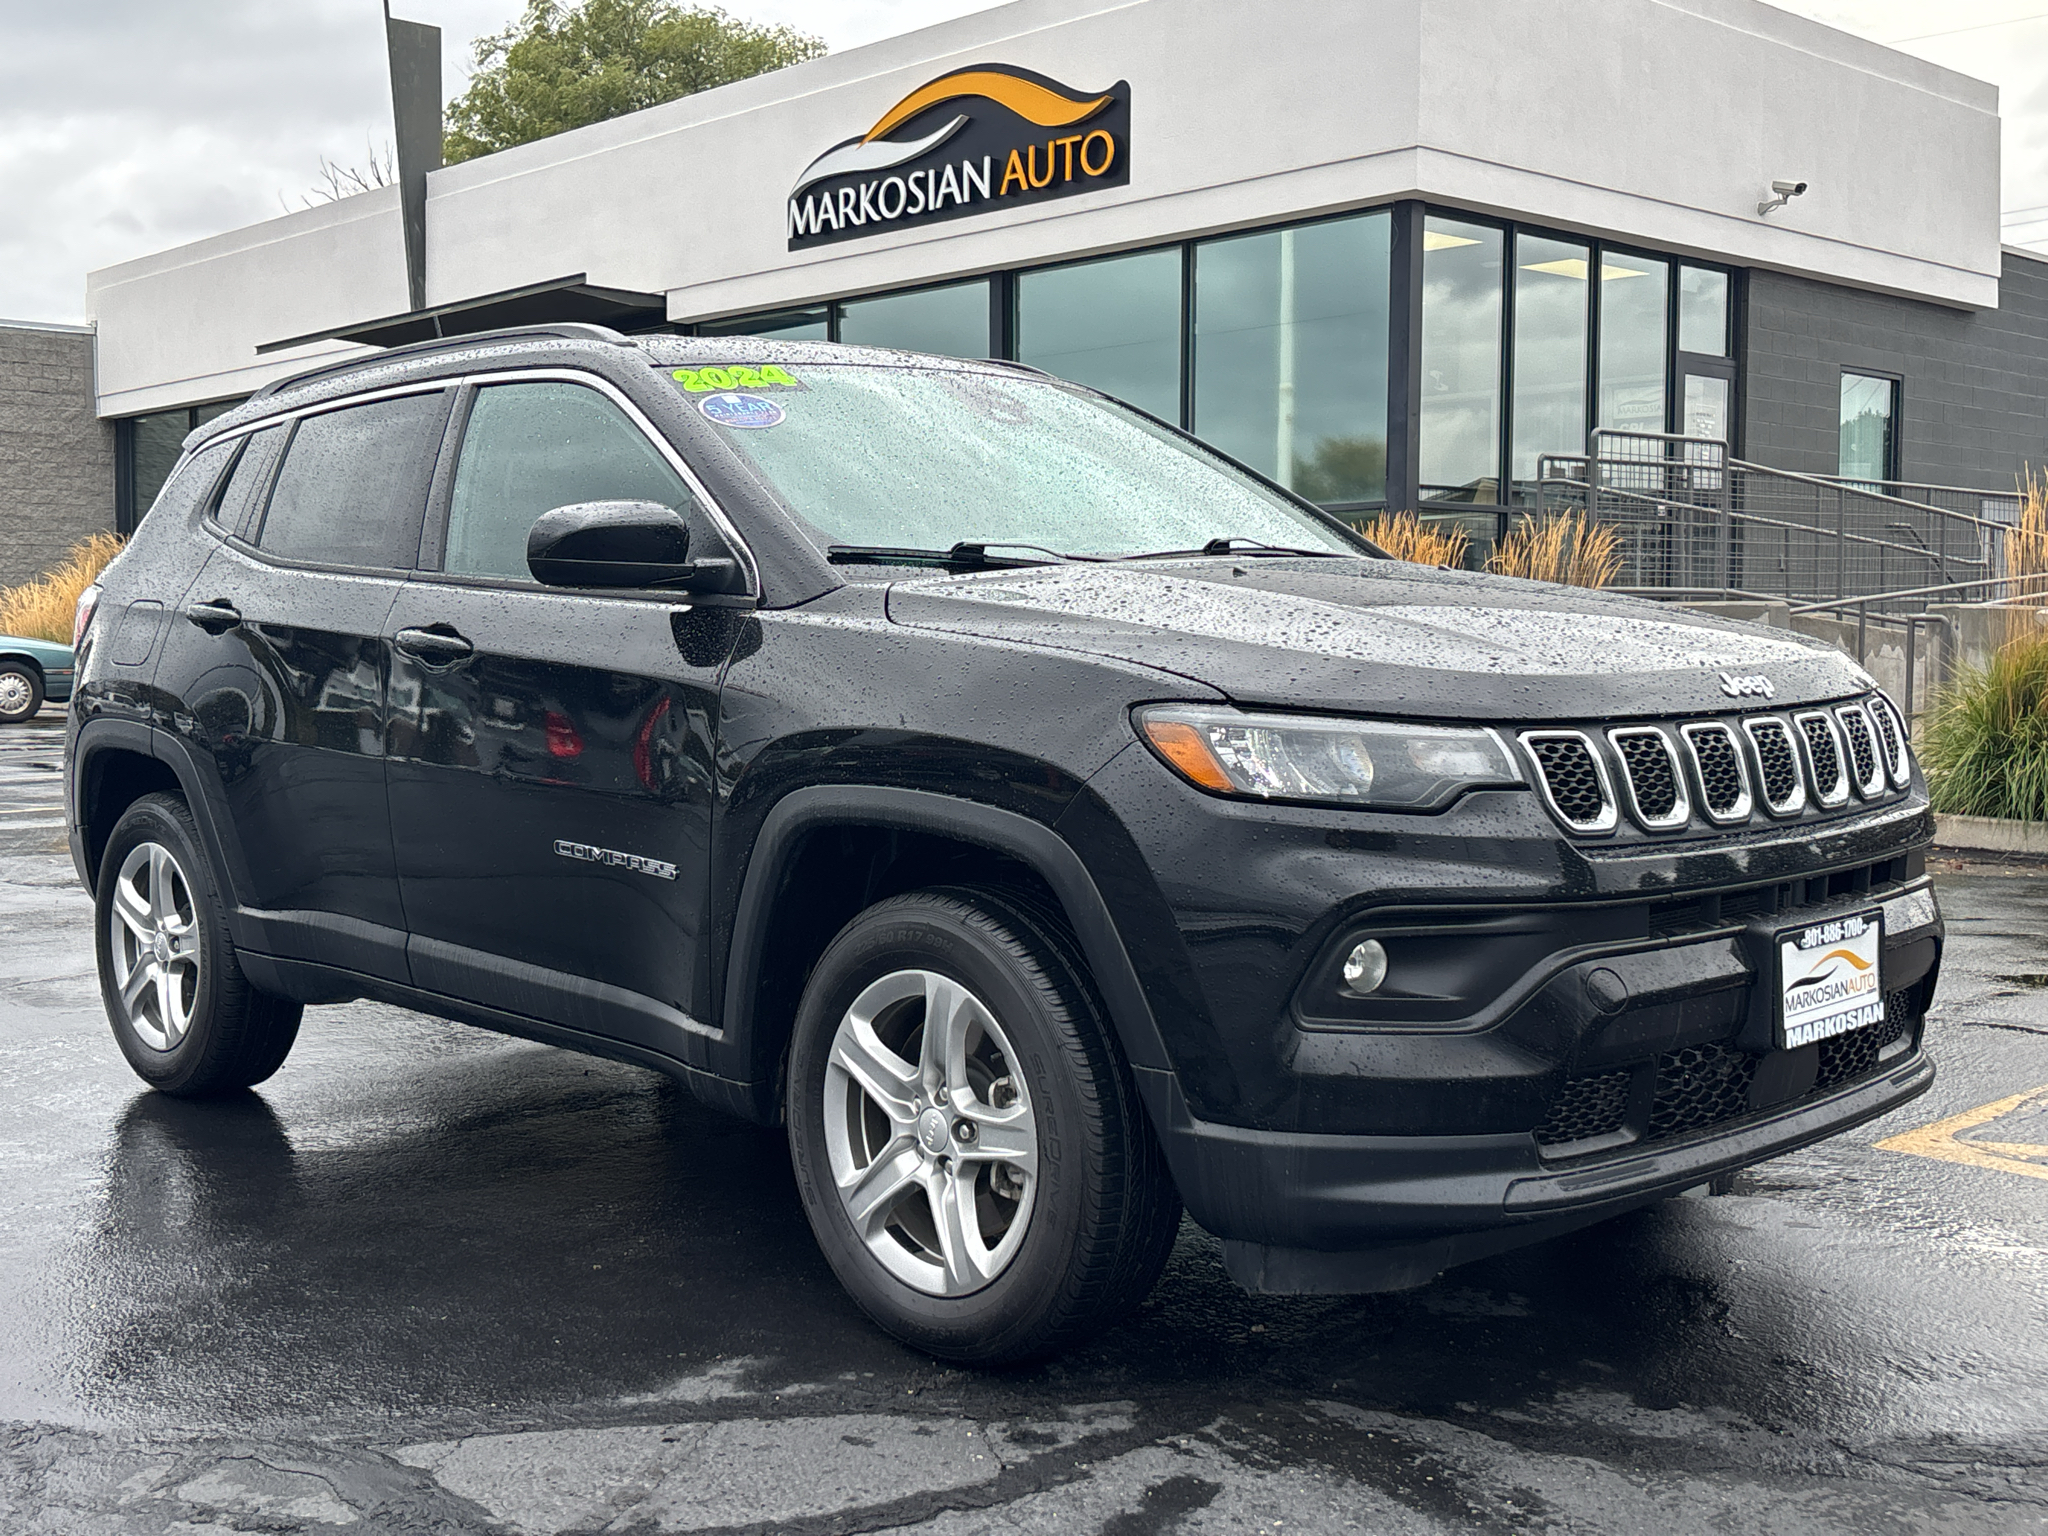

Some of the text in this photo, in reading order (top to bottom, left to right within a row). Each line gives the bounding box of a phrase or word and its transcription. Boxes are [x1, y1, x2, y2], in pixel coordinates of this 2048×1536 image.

[787, 129, 1115, 239] MARKOSIAN AUTO
[672, 365, 797, 392] 2024
[705, 401, 774, 415] 5 YEAR
[1617, 404, 1662, 415] MARKOSIA
[1719, 671, 1775, 698] Jeep
[553, 839, 680, 881] COMPASS
[897, 930, 923, 943] R17
[1804, 917, 1864, 948] 801-886-1700
[1786, 1001, 1885, 1049] MARKOSIAN
